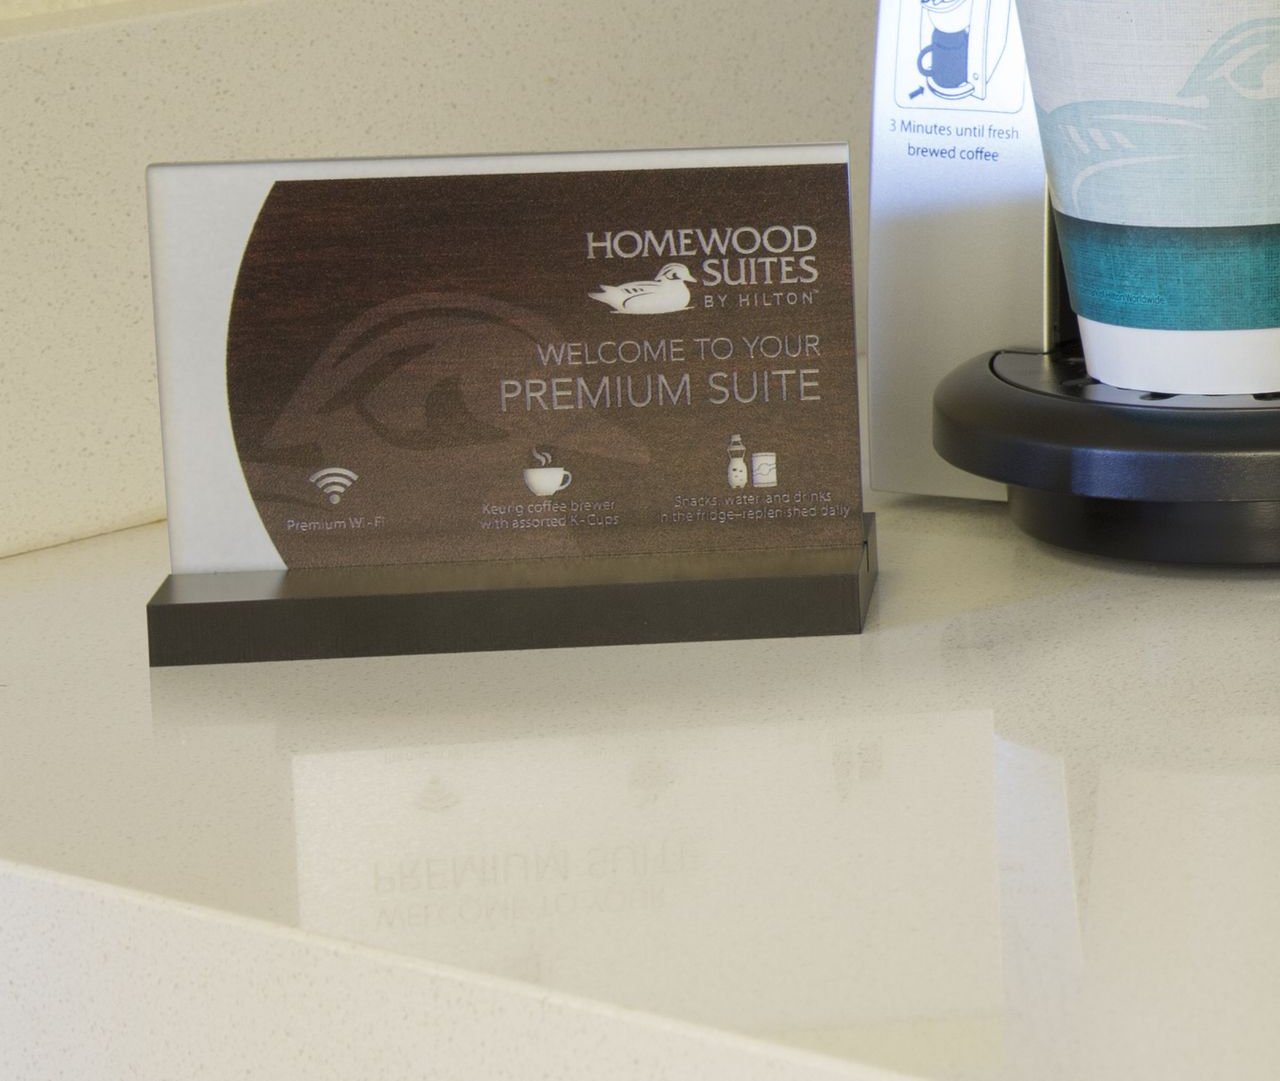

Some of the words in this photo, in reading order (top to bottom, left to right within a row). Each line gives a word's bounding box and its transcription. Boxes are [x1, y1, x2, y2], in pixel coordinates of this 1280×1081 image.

[889, 118, 896, 132] 3
[900, 119, 952, 137] Minutes
[955, 123, 985, 138] until
[987, 124, 1019, 140] fresh
[907, 143, 956, 160] brewed
[959, 146, 999, 162] coffee
[586, 226, 817, 260] HOMEWOOD
[702, 255, 819, 287] SUITES
[704, 294, 728, 308] BY
[738, 291, 814, 307] HILTON
[536, 338, 685, 366] WELCOME
[693, 336, 734, 361] TO
[742, 334, 821, 359] YOUR
[500, 373, 691, 412] PREMIUM
[708, 368, 821, 404] SUITE
[287, 517, 347, 532] Premium
